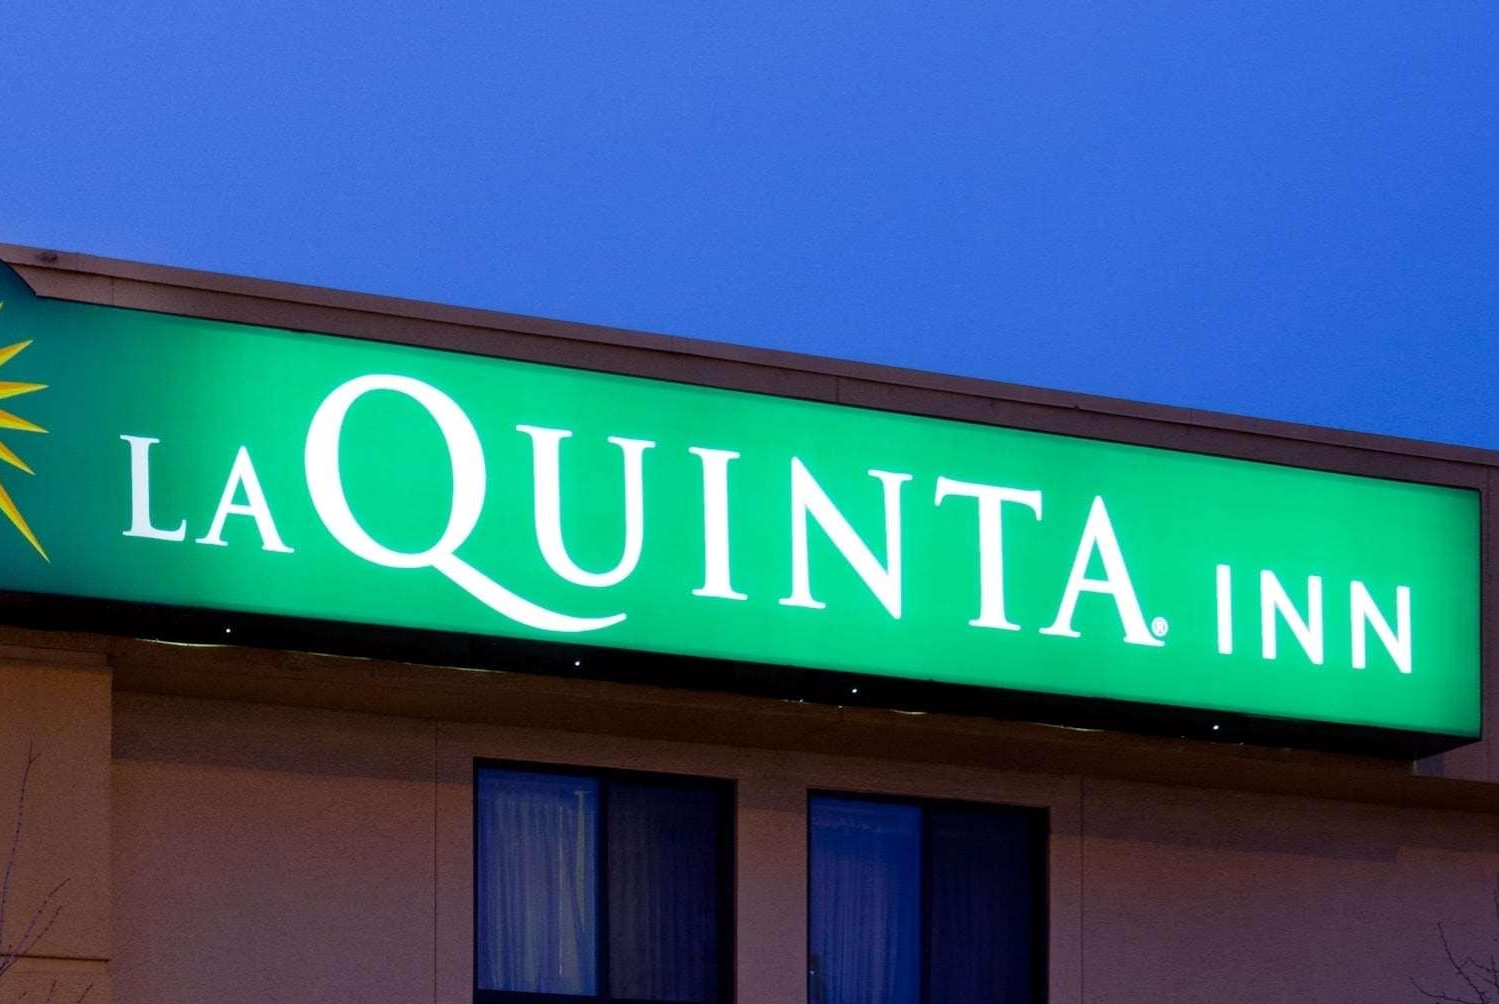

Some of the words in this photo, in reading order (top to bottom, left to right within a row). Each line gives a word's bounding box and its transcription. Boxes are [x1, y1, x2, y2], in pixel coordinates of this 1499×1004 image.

[120, 435, 294, 553] LA
[304, 374, 1165, 647] QUINTA
[1216, 564, 1412, 674] INN
